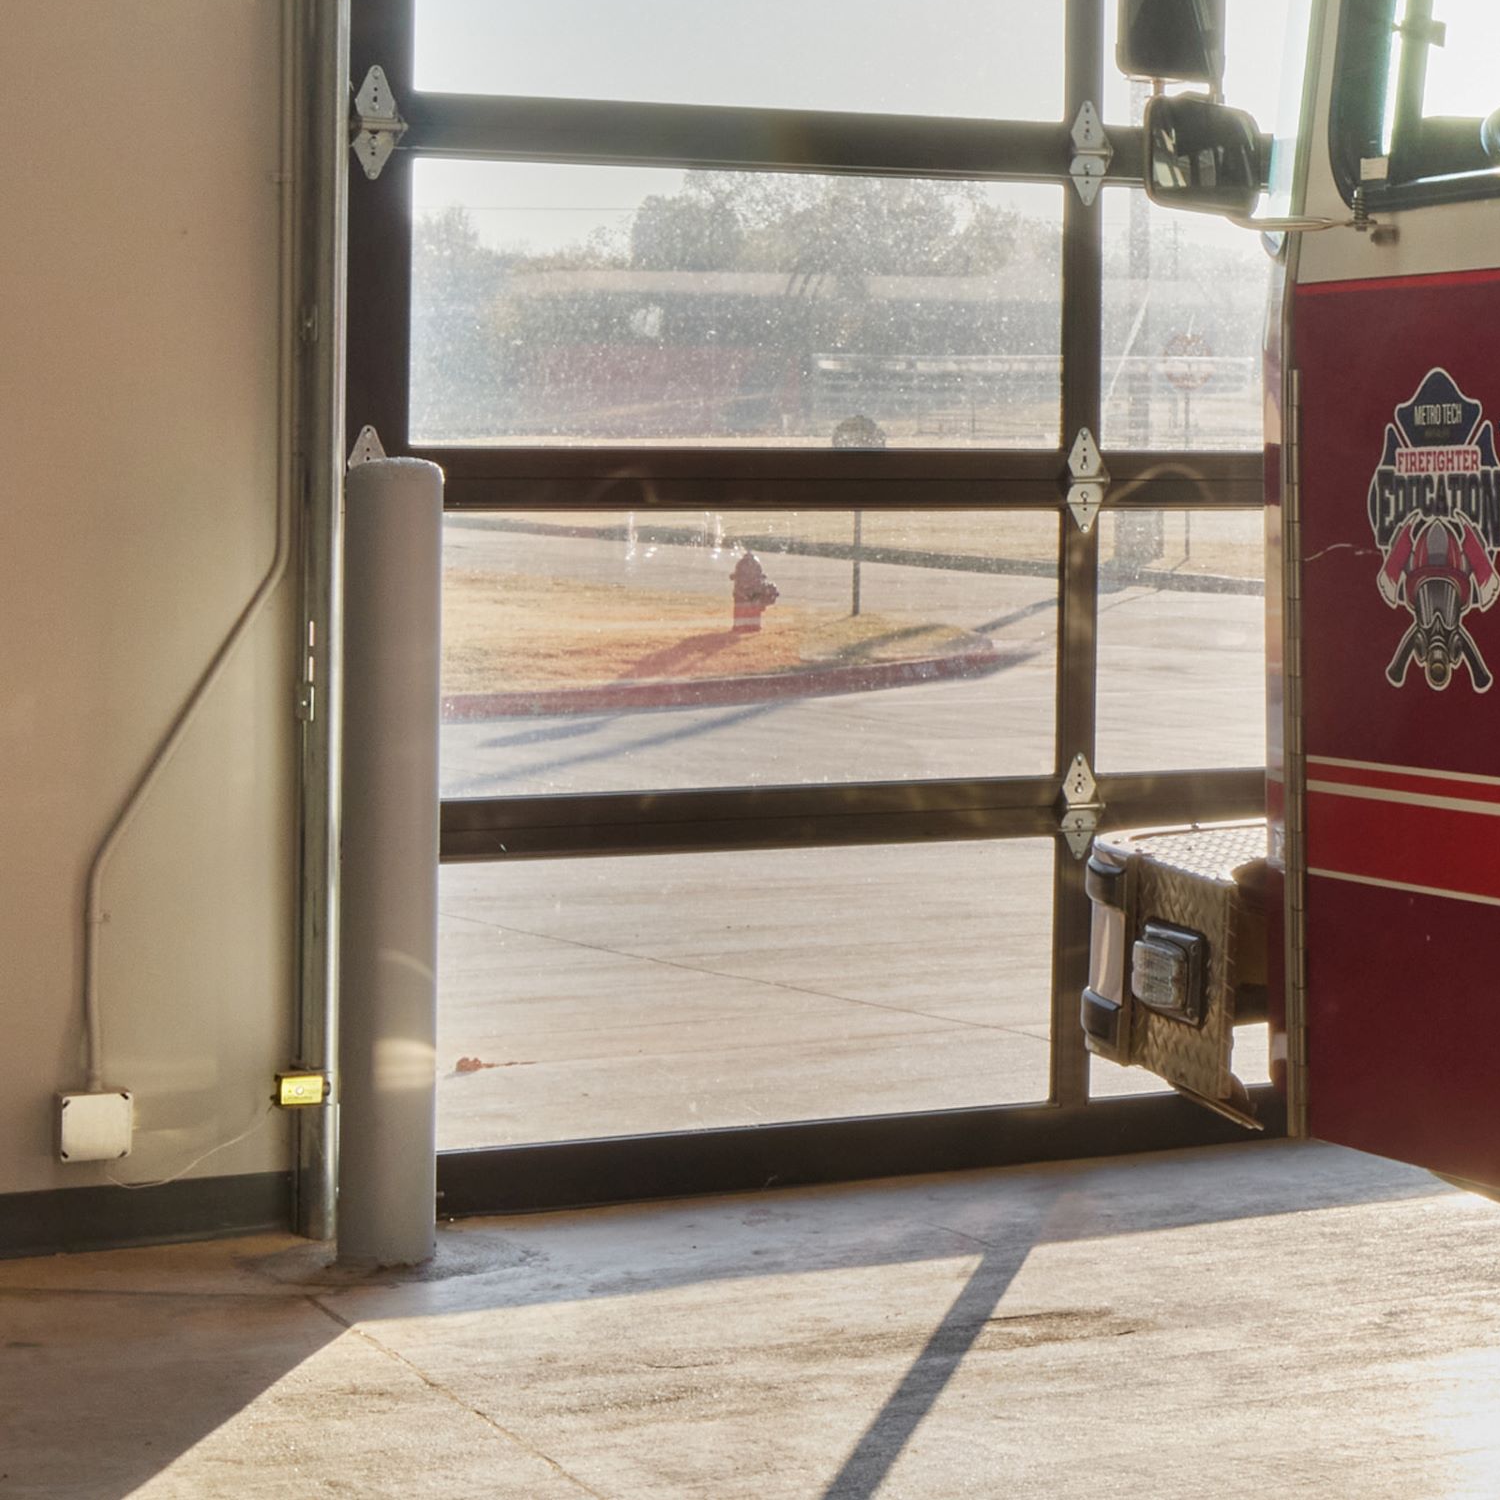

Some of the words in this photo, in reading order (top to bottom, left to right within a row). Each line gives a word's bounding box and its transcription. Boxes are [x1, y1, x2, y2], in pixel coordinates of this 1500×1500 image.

[1414, 404, 1441, 426] METRO
[1443, 403, 1462, 425] TECH
[1397, 450, 1480, 473] FIREFIGHTER
